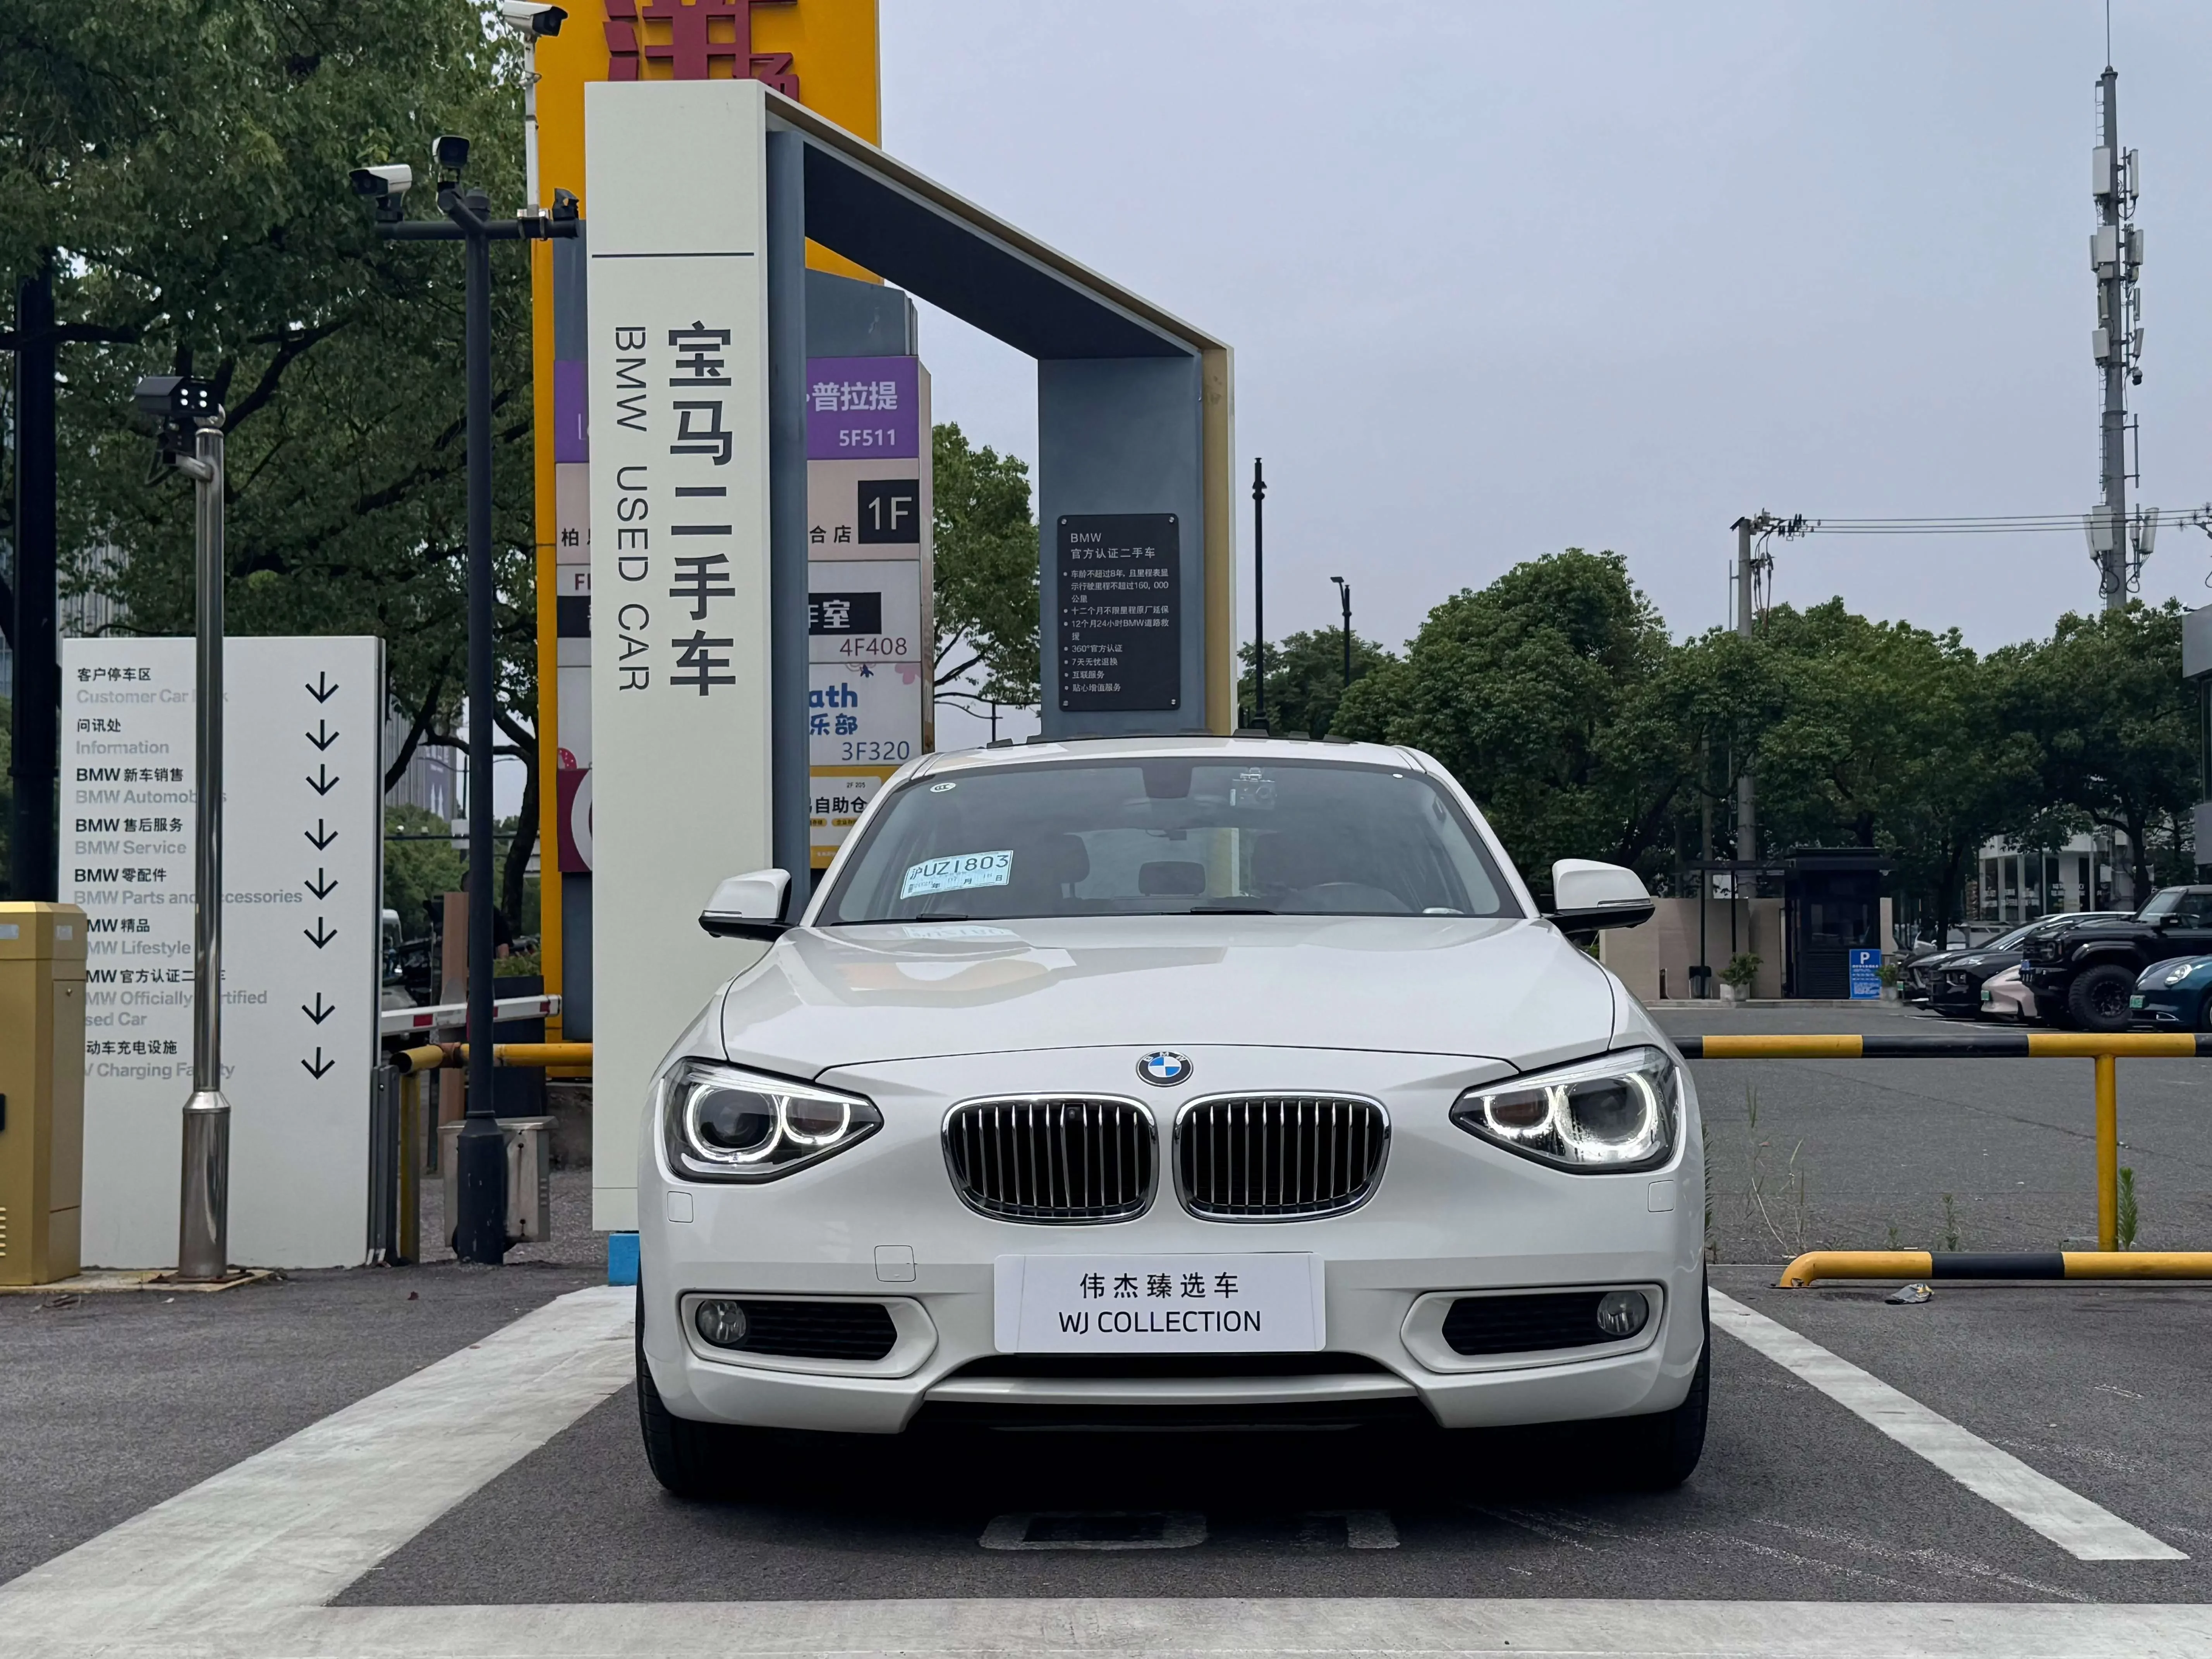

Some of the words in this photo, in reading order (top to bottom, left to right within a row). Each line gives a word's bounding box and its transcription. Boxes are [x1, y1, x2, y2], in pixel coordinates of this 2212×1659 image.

[616, 327, 647, 432] BMW
[812, 381, 898, 412] 普拉提
[839, 429, 895, 446] 5F511
[668, 320, 736, 696] 宝马二手车
[869, 496, 912, 530] 1F
[617, 466, 648, 582] USED
[1071, 533, 1102, 543] BMW
[1071, 547, 1156, 559] 官方认证二手车
[1072, 594, 1088, 603] 公里
[618, 603, 649, 691] CAR
[840, 637, 907, 656] 4F408
[77, 667, 151, 682] 客户停车区
[77, 689, 156, 704] Customer
[159, 689, 189, 703] Car
[809, 682, 858, 708] ath
[77, 719, 121, 733] 问讯处
[810, 713, 859, 736] 乐部
[76, 741, 169, 755] Information
[842, 740, 910, 762] 3F320
[76, 768, 120, 782] BMW
[124, 768, 184, 782] 新车销售
[76, 790, 120, 804] BMW
[124, 789, 227, 804] Automobs
[809, 796, 868, 814] 自助仓
[76, 819, 120, 832] BMW
[124, 817, 183, 832] 售后服务
[75, 841, 120, 855] BMW
[124, 840, 187, 855] Service
[75, 869, 119, 882] BMW
[122, 867, 167, 883] 零配件
[74, 891, 118, 905] BMW
[122, 890, 165, 904] Parts
[87, 919, 118, 933] MW
[121, 918, 150, 933] 精品
[88, 941, 118, 955] MW
[122, 940, 191, 958] Lifestyle
[86, 969, 117, 983] MW
[120, 968, 226, 984] 官方认证二
[86, 991, 117, 1005] MW
[120, 991, 193, 1008] Officially
[222, 990, 268, 1004] tified
[86, 1012, 114, 1026] sed
[118, 1012, 148, 1026] Car
[86, 1040, 177, 1054] 动车充电设施
[97, 1062, 172, 1080] Charging
[1080, 1271, 1239, 1299] 伟杰臻选车
[1059, 1312, 1089, 1335] WJ
[1097, 1311, 1261, 1333] COLLECTION
